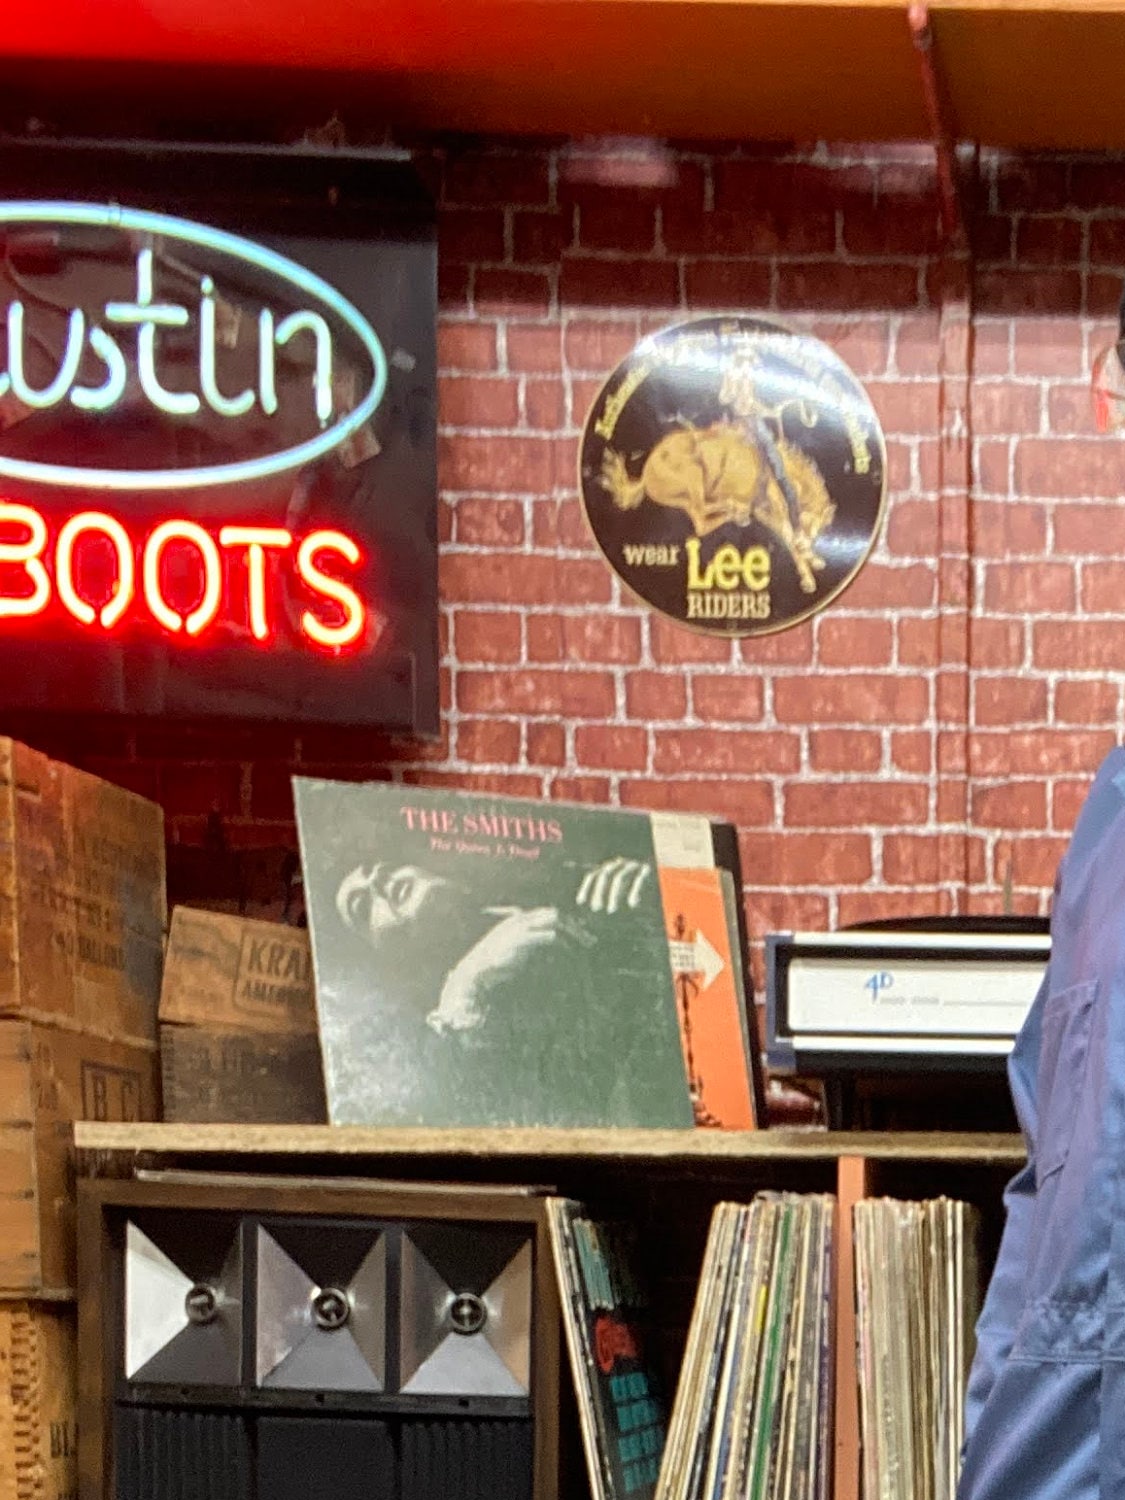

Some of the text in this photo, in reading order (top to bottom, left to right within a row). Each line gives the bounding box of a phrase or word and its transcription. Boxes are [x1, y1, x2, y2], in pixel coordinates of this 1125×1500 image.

[0, 248, 333, 424] ustin
[0, 502, 364, 646] BOOTS
[622, 537, 771, 591] wear Lee
[686, 591, 771, 619] RIDERS
[400, 806, 563, 842] THE SMITHS
